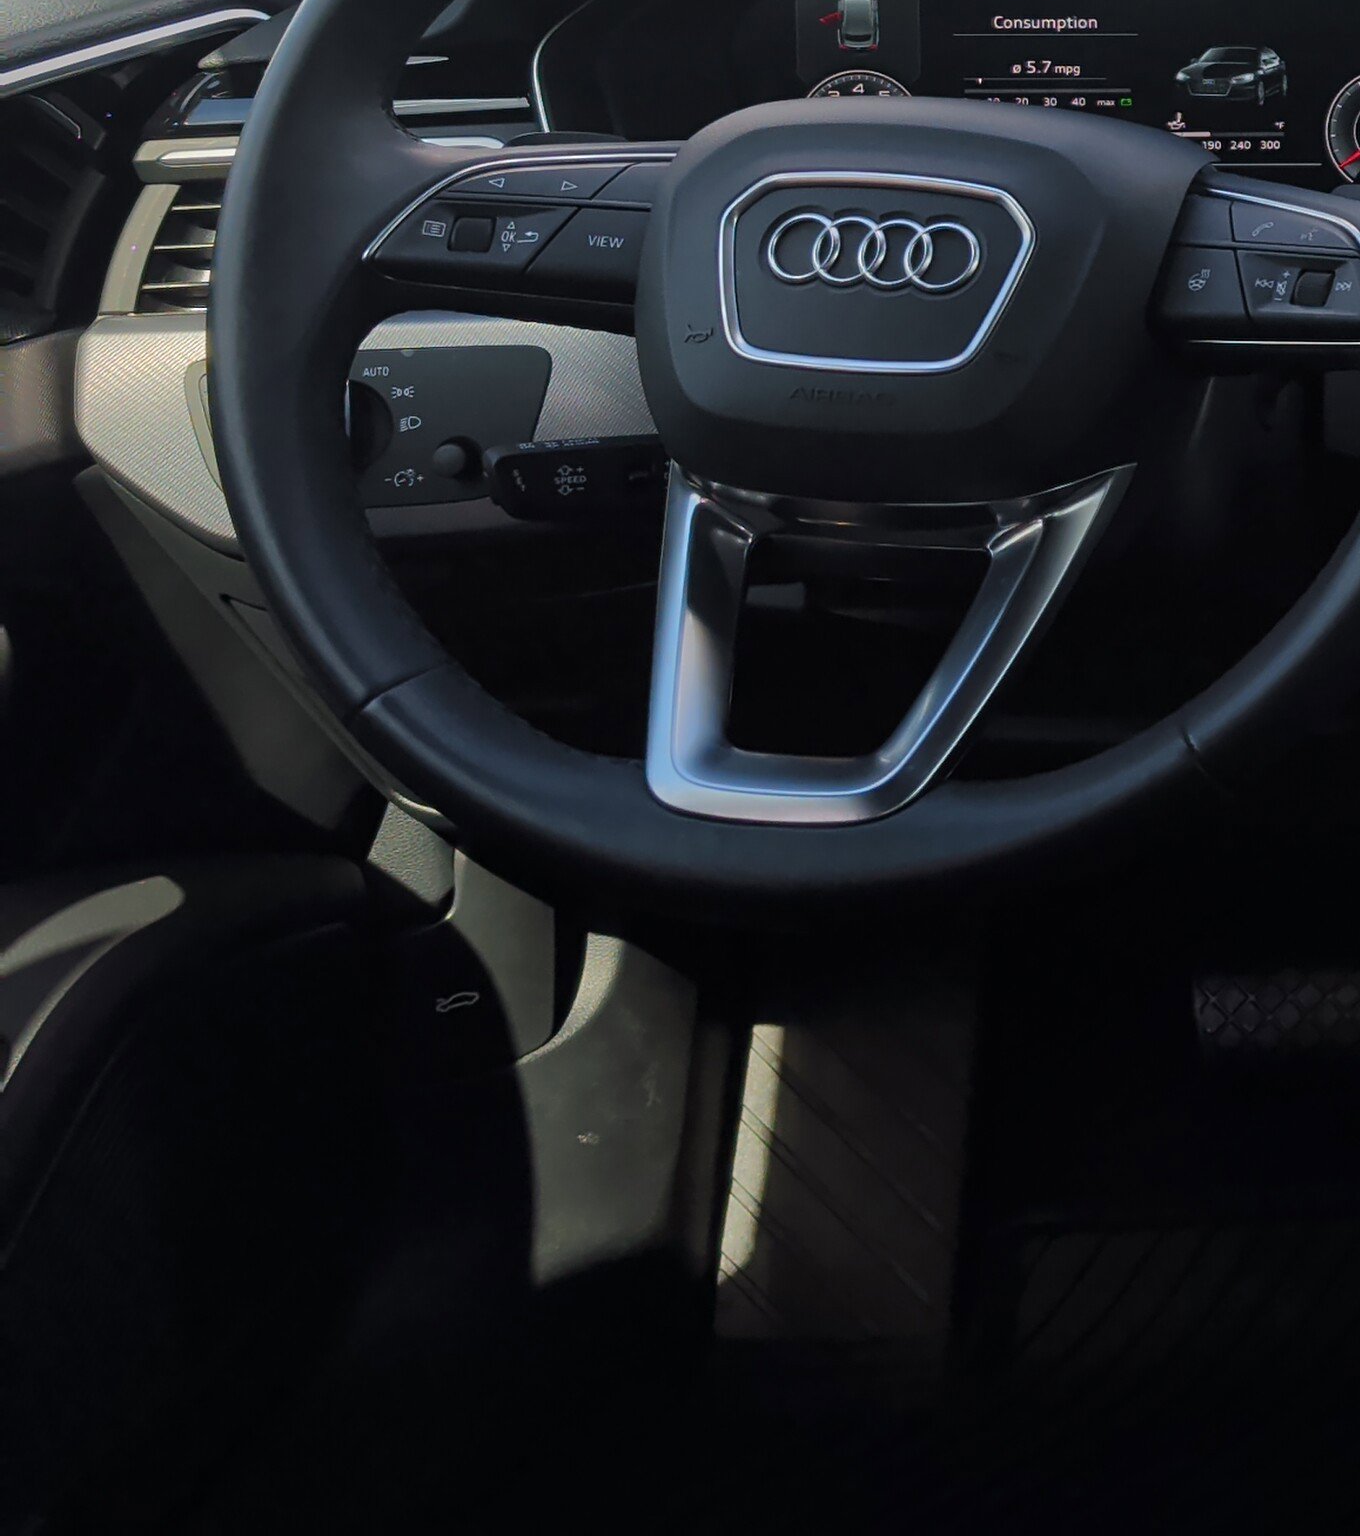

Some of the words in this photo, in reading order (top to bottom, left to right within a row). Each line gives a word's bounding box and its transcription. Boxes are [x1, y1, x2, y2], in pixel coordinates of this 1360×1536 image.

[993, 16, 1098, 32] Consumption
[1026, 61, 1052, 74] 5.7
[1054, 65, 1081, 76] mpg
[852, 83, 865, 94] 4
[1044, 97, 1058, 107] 30
[1071, 97, 1087, 107] 40
[1097, 99, 1116, 107] max
[1202, 139, 1222, 151] 190
[1230, 139, 1251, 151] 240
[1260, 139, 1281, 151] 300
[501, 230, 517, 243] OK
[587, 234, 625, 249] VIEW
[362, 366, 390, 378] AUTO
[554, 474, 587, 484] SPEED
